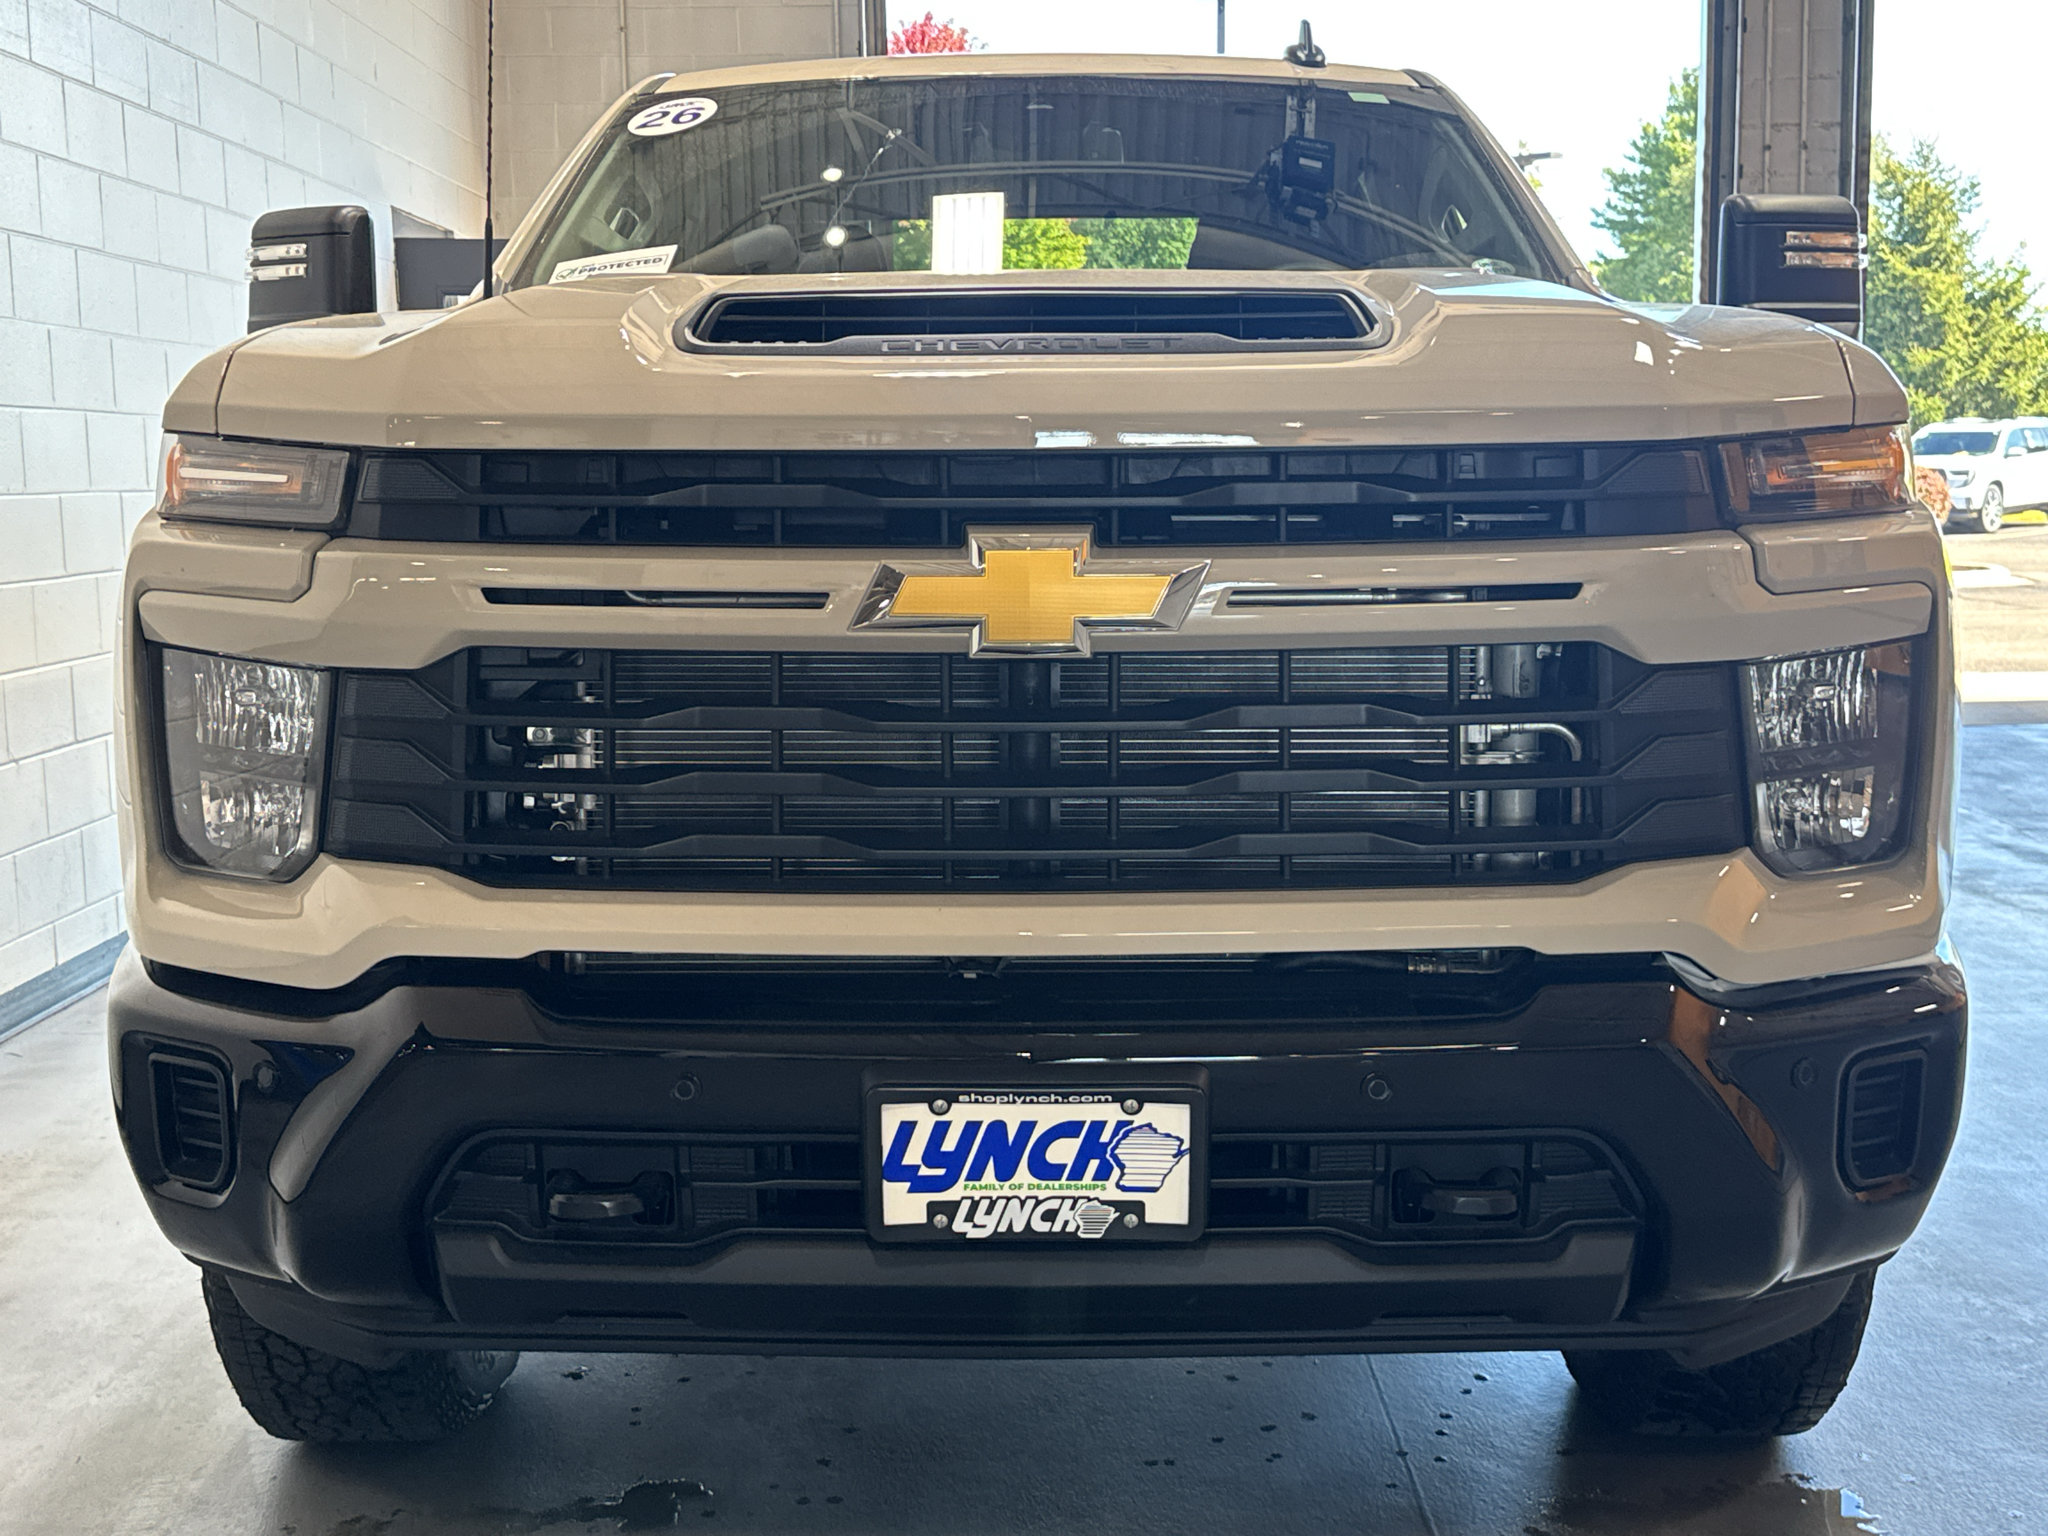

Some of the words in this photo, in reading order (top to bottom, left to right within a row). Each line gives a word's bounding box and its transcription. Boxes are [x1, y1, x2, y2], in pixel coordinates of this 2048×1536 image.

[634, 107, 706, 130] 26
[578, 257, 664, 275] PROTECTED
[881, 338, 1183, 352] CHEVROLET
[958, 1093, 1113, 1105] shoplynch.com
[882, 1119, 1135, 1194] LYNCH
[963, 1183, 1004, 1192] FAMILY
[1008, 1183, 1024, 1192] OF
[1027, 1183, 1107, 1192] DEALERSHIPS
[951, 1196, 1090, 1239] LYNCH
